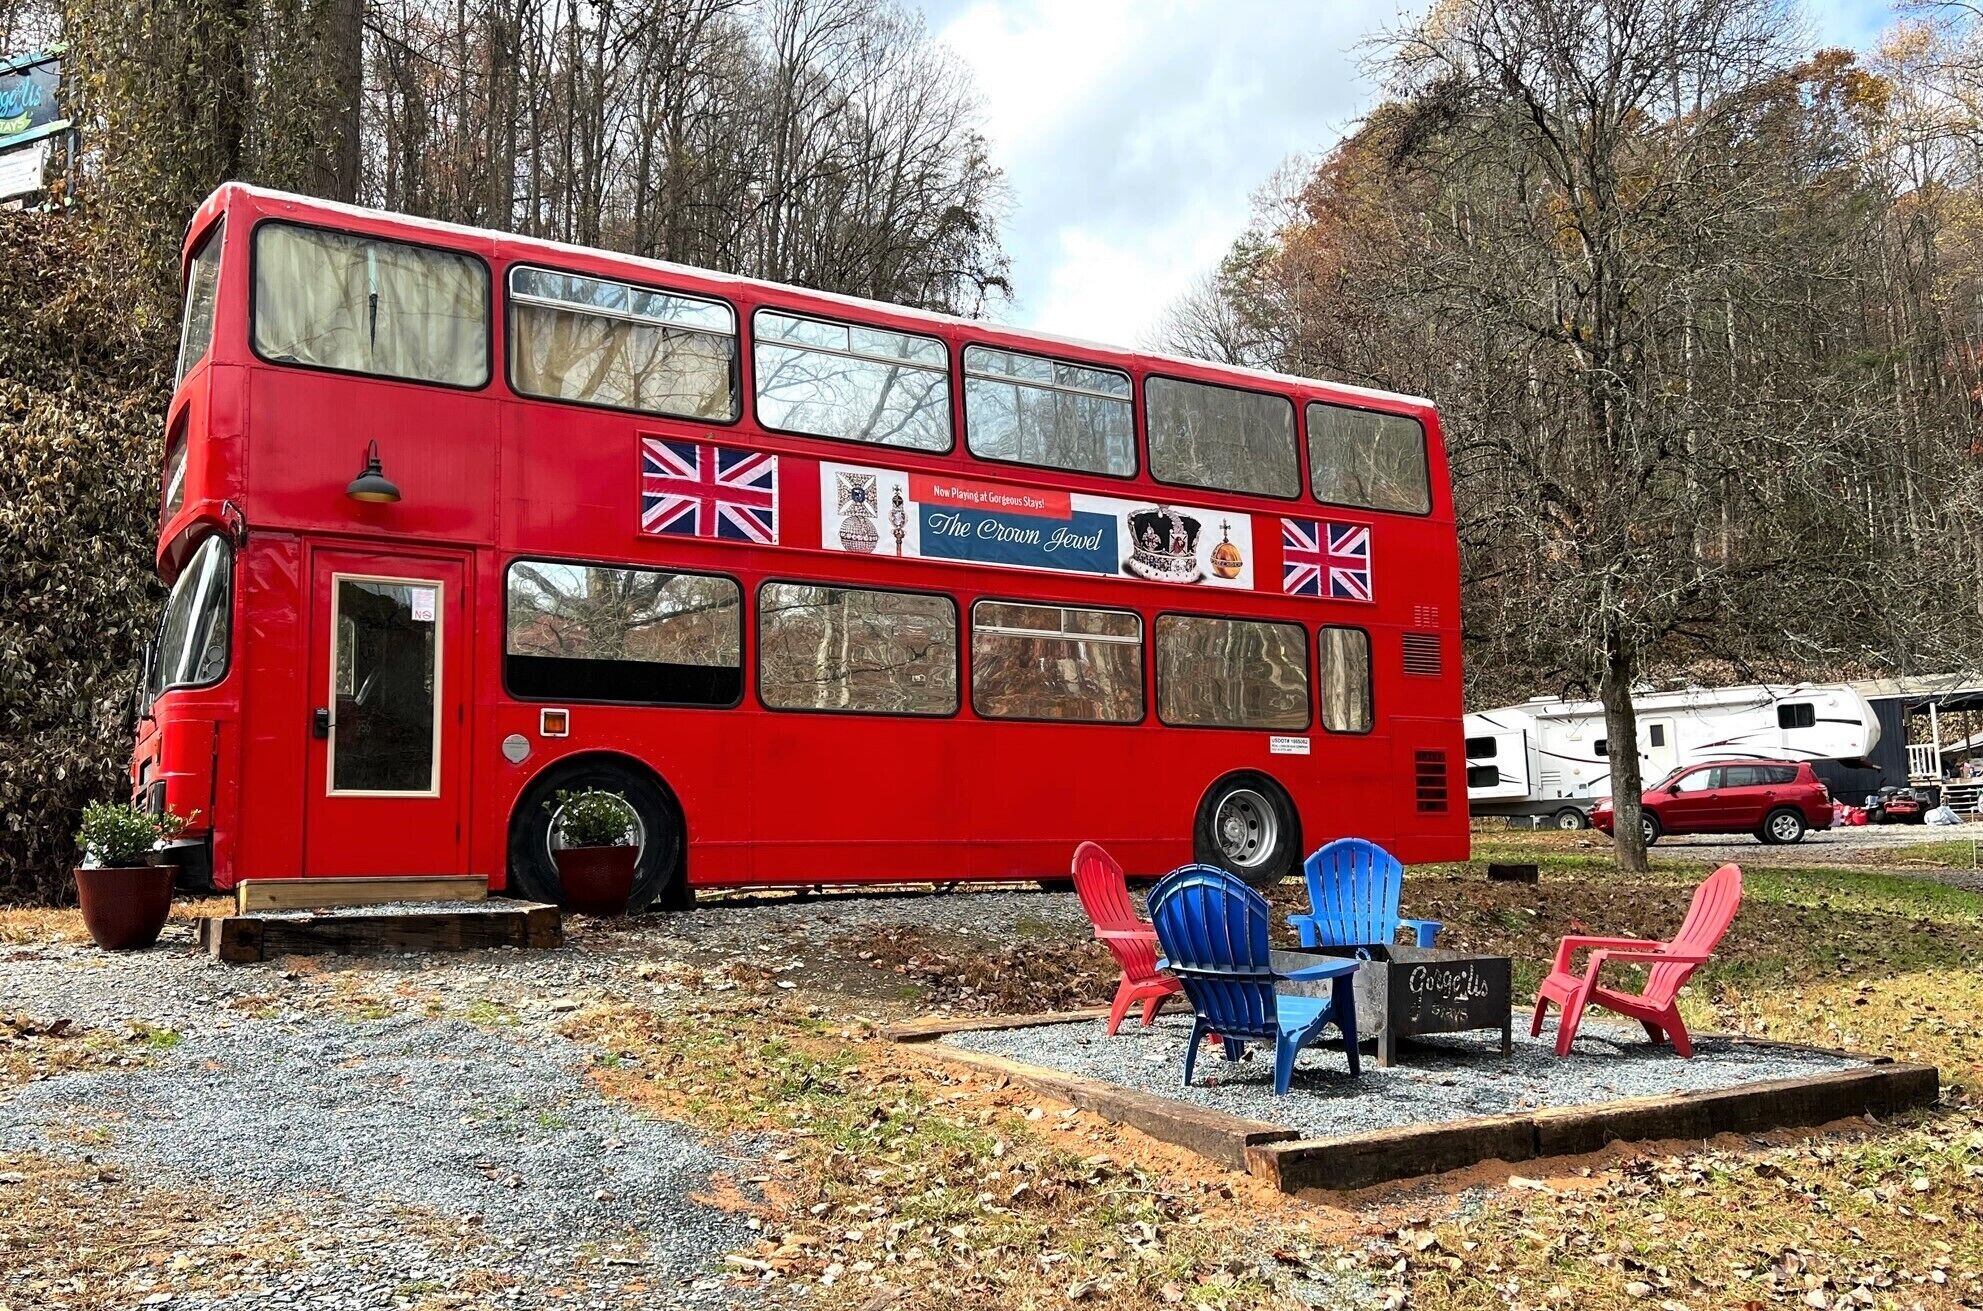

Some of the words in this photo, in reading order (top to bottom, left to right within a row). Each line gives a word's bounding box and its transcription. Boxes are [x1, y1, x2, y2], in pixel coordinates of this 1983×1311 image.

[0, 119, 23, 132] TAYS
[933, 485, 950, 498] Now
[951, 487, 979, 503] Playing
[979, 492, 988, 502] at
[988, 493, 1023, 506] Gorgeous
[1023, 496, 1045, 509] Stays!
[928, 513, 971, 537] The
[976, 518, 1041, 545] Crown
[1043, 527, 1103, 552] Jewel
